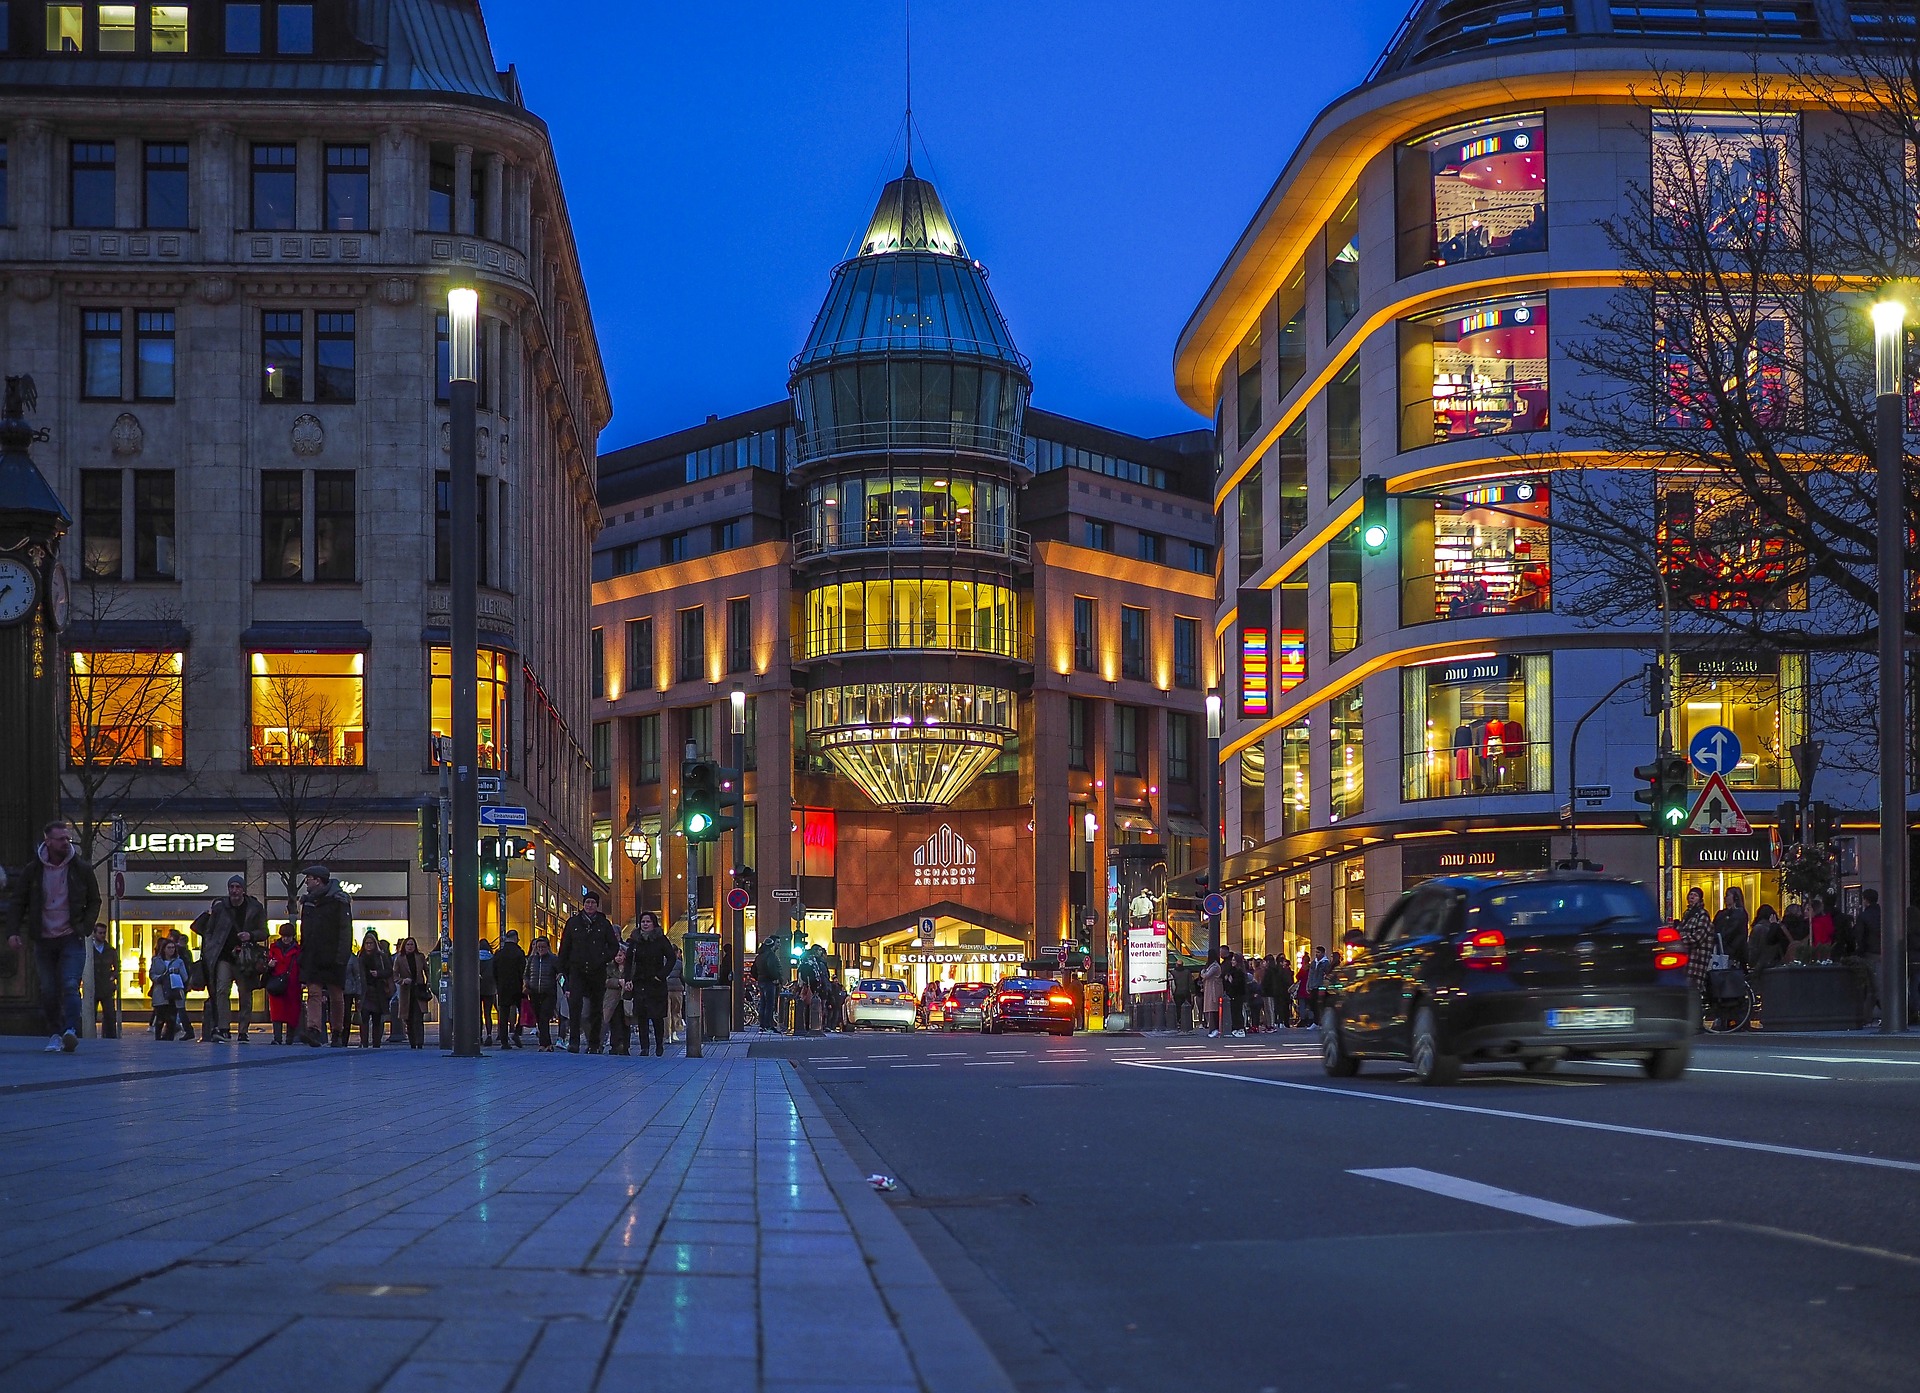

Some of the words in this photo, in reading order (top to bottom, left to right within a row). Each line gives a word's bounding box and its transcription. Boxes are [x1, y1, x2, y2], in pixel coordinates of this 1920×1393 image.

[914, 867, 976, 877] SCHADOW
[914, 876, 975, 886] ARKADEN
[899, 953, 963, 963] SCHADOW
